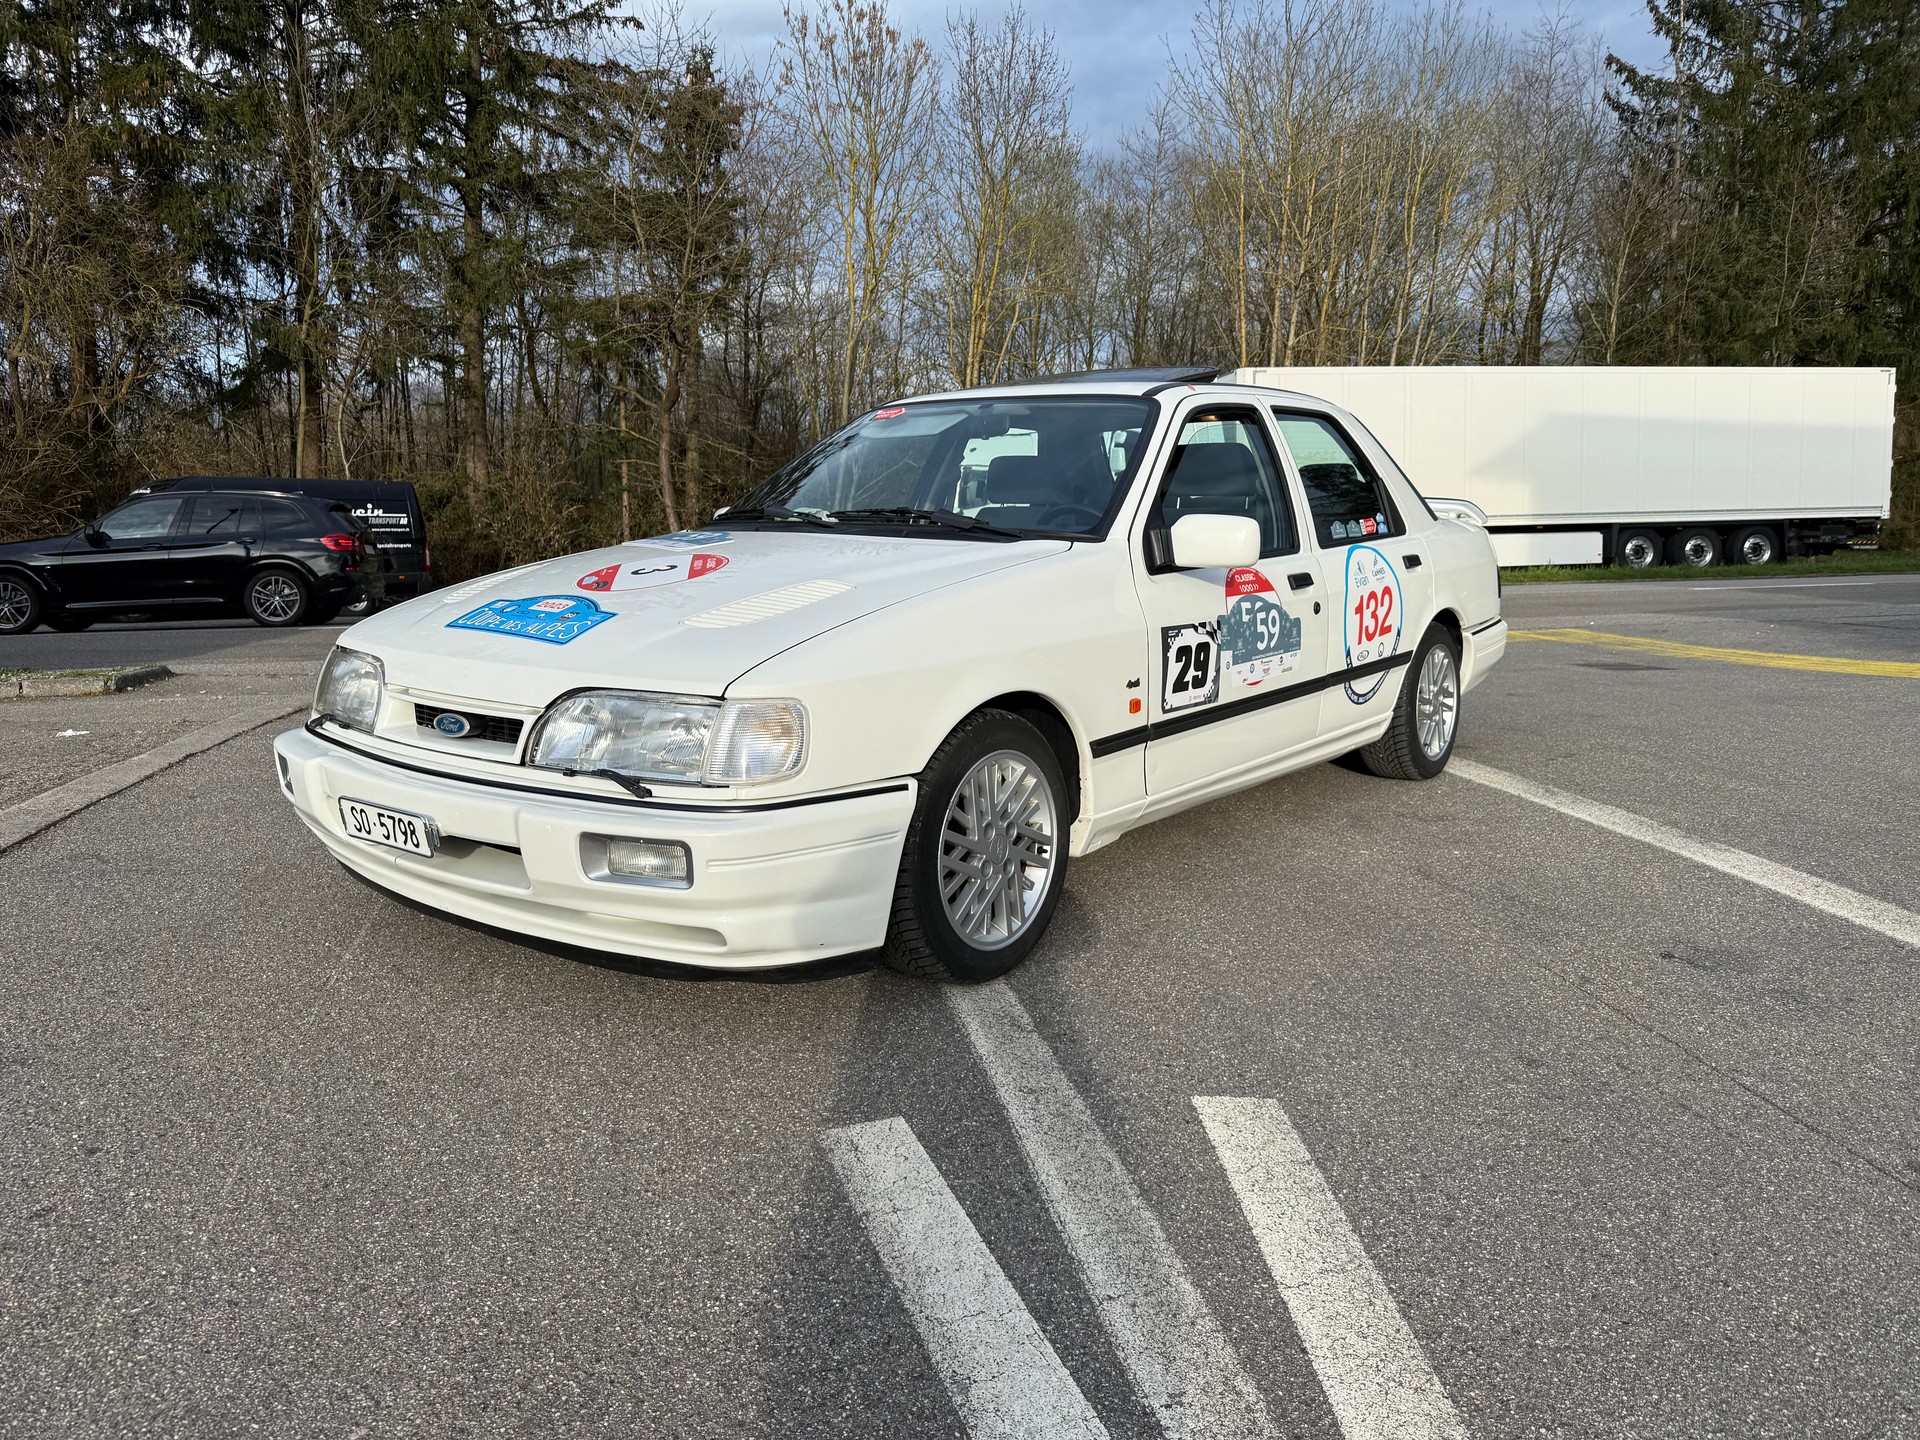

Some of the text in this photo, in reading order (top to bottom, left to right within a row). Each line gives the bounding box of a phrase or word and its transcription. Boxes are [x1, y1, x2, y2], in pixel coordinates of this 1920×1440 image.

[368, 517, 408, 525] TRANSPORT AG
[1234, 573, 1256, 583] CLASSIC
[536, 601, 570, 611] 2023
[1354, 585, 1393, 646] 132
[457, 607, 506, 628] COUPE
[499, 620, 527, 632] DES
[522, 619, 592, 640] ALPES
[1256, 608, 1280, 651] 59
[1172, 641, 1211, 694] 29
[440, 717, 460, 734] Ford
